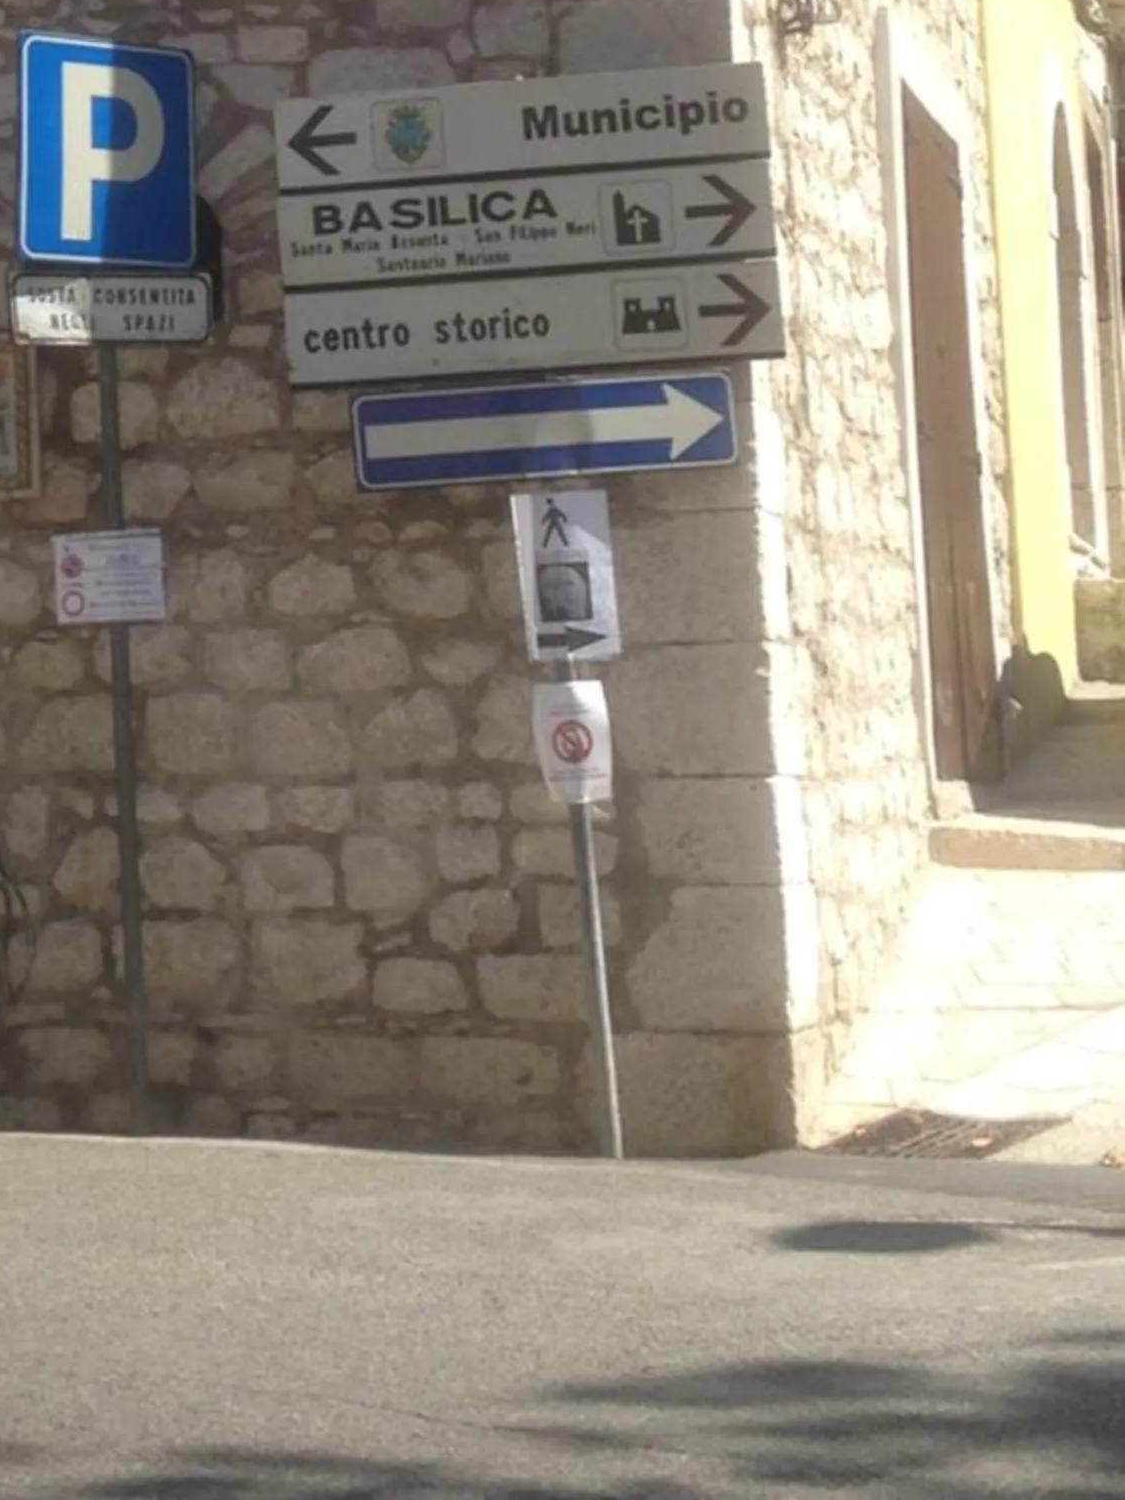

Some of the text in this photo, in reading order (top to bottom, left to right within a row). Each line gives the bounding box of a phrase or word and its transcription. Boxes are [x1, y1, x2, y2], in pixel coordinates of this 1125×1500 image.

[521, 91, 750, 141] Municipio
[60, 60, 164, 241] P
[312, 188, 558, 236] BASILICA
[290, 240, 334, 258] Santa
[341, 236, 381, 254] Maria
[475, 226, 502, 244] San
[376, 255, 448, 274] Santuario
[94, 285, 196, 306] CONSENTITA
[123, 314, 175, 333] SPAZI
[303, 308, 551, 354] centro storico
